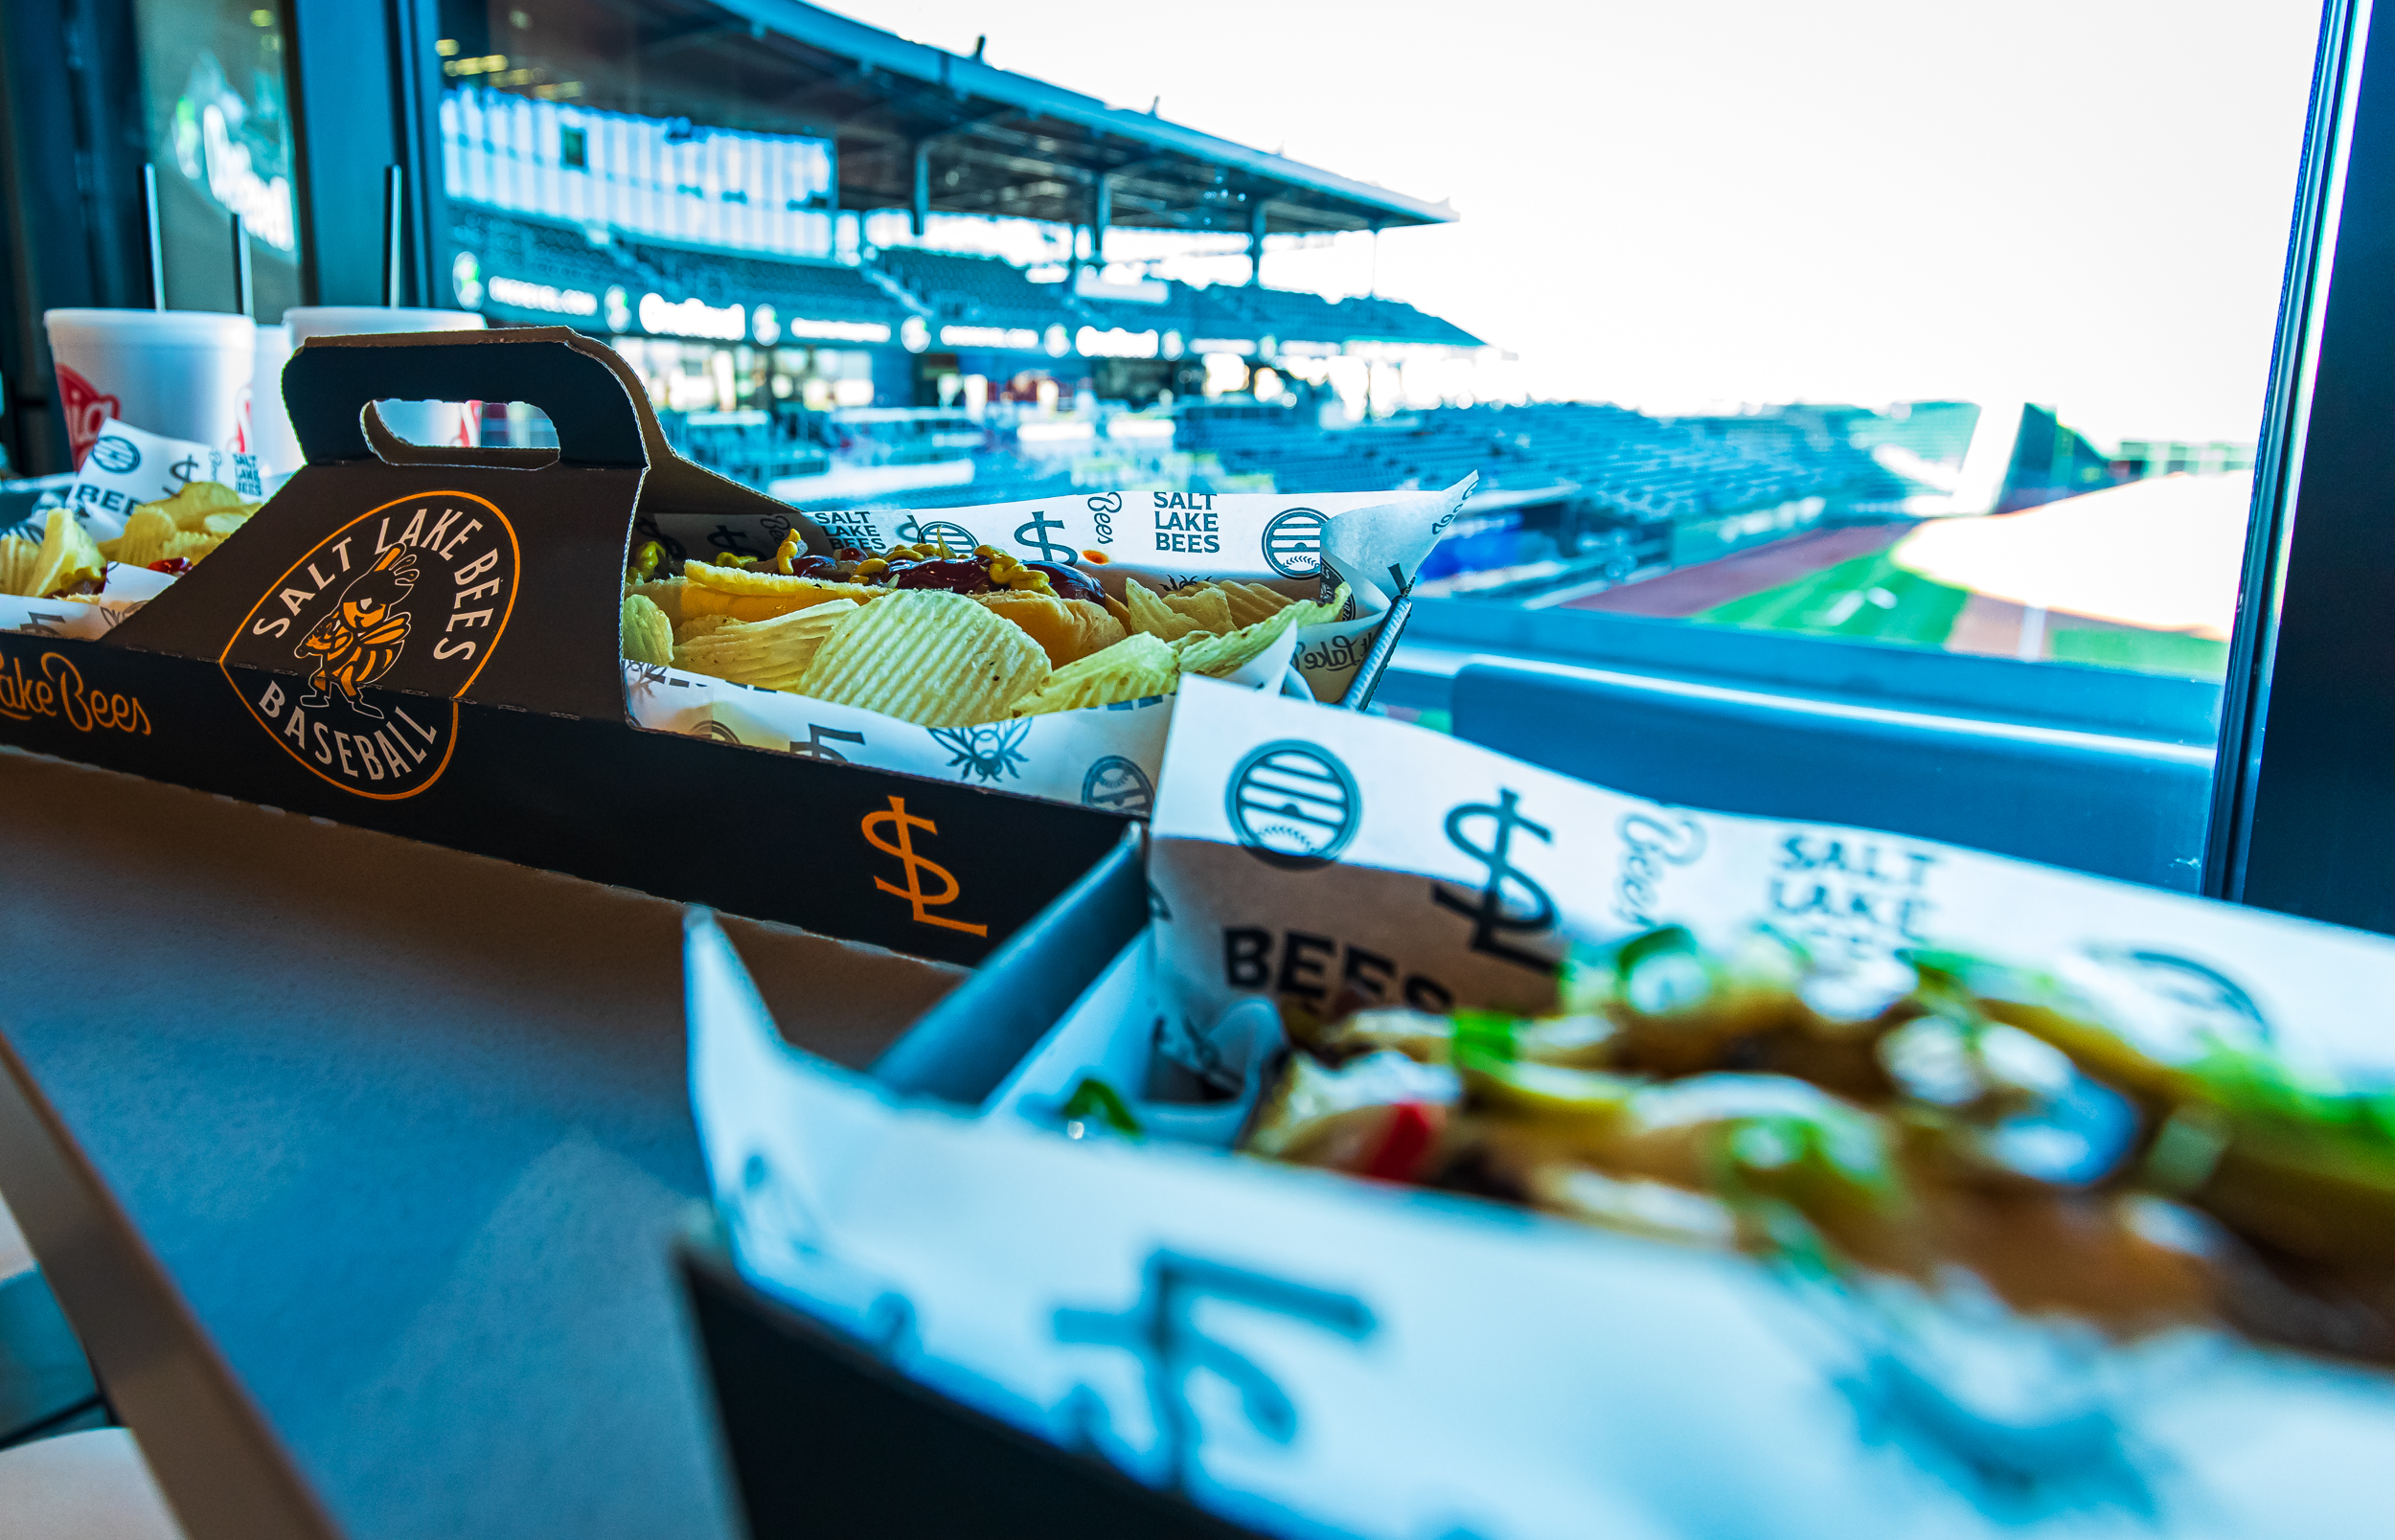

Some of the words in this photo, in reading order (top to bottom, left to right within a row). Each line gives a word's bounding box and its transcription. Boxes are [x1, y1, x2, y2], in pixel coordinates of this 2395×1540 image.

[1153, 491, 1218, 510] SALT
[815, 510, 871, 525] SALT
[1087, 491, 1123, 544] Bees
[1154, 510, 1220, 532] LAKE
[823, 524, 880, 537] LAKE
[1155, 532, 1220, 554] BEES
[253, 536, 353, 639] SALT
[375, 509, 484, 561] LAKE
[433, 548, 501, 661] BEES
[41, 651, 152, 736] Bees
[258, 680, 438, 781] BASEBALL
